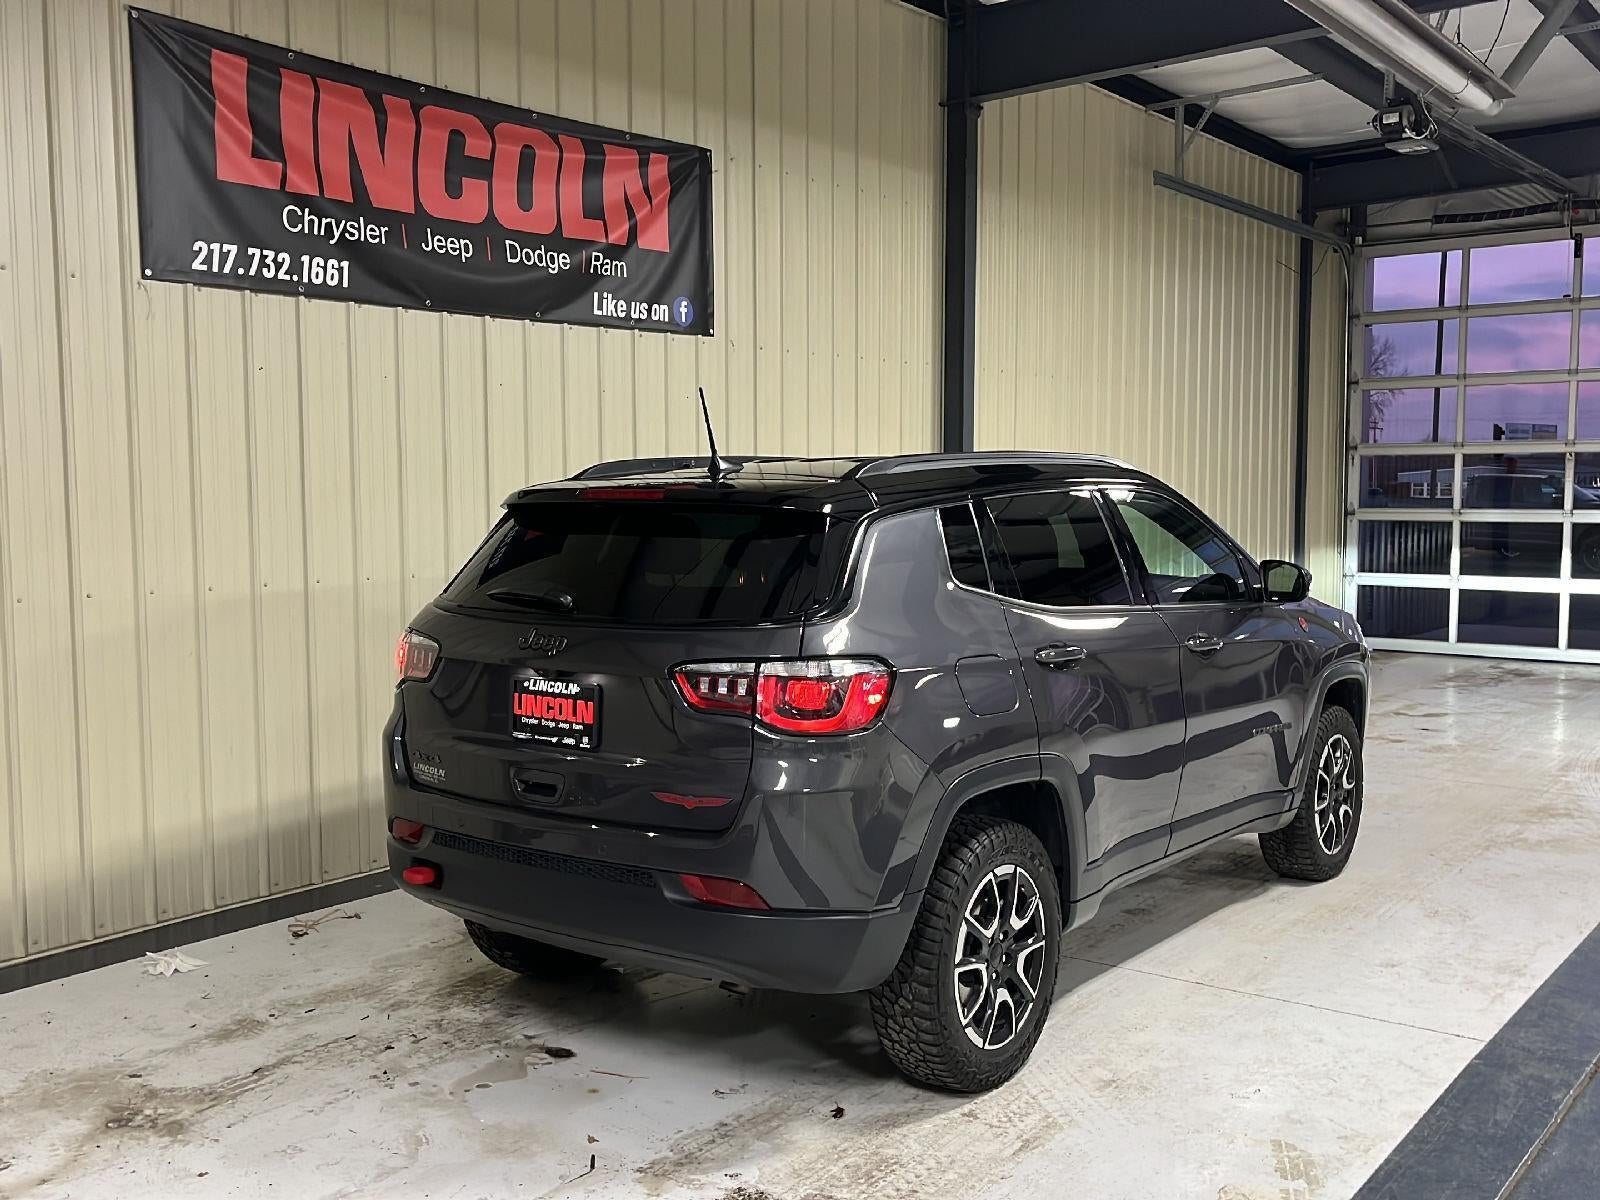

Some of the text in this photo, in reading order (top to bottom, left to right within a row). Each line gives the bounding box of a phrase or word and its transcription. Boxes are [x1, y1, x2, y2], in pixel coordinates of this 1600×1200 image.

[210, 48, 671, 253] LINCOLN
[282, 204, 628, 278] Chrysler Jeep Dodge Ram
[191, 240, 350, 288] 217.732.1661
[593, 291, 627, 318] Like
[630, 303, 649, 320] us
[651, 304, 669, 322] on
[518, 627, 568, 656] Jeep
[528, 679, 578, 694] LINCOLN
[513, 692, 594, 725] LINCOLN
[413, 762, 446, 778] LINCOLN
